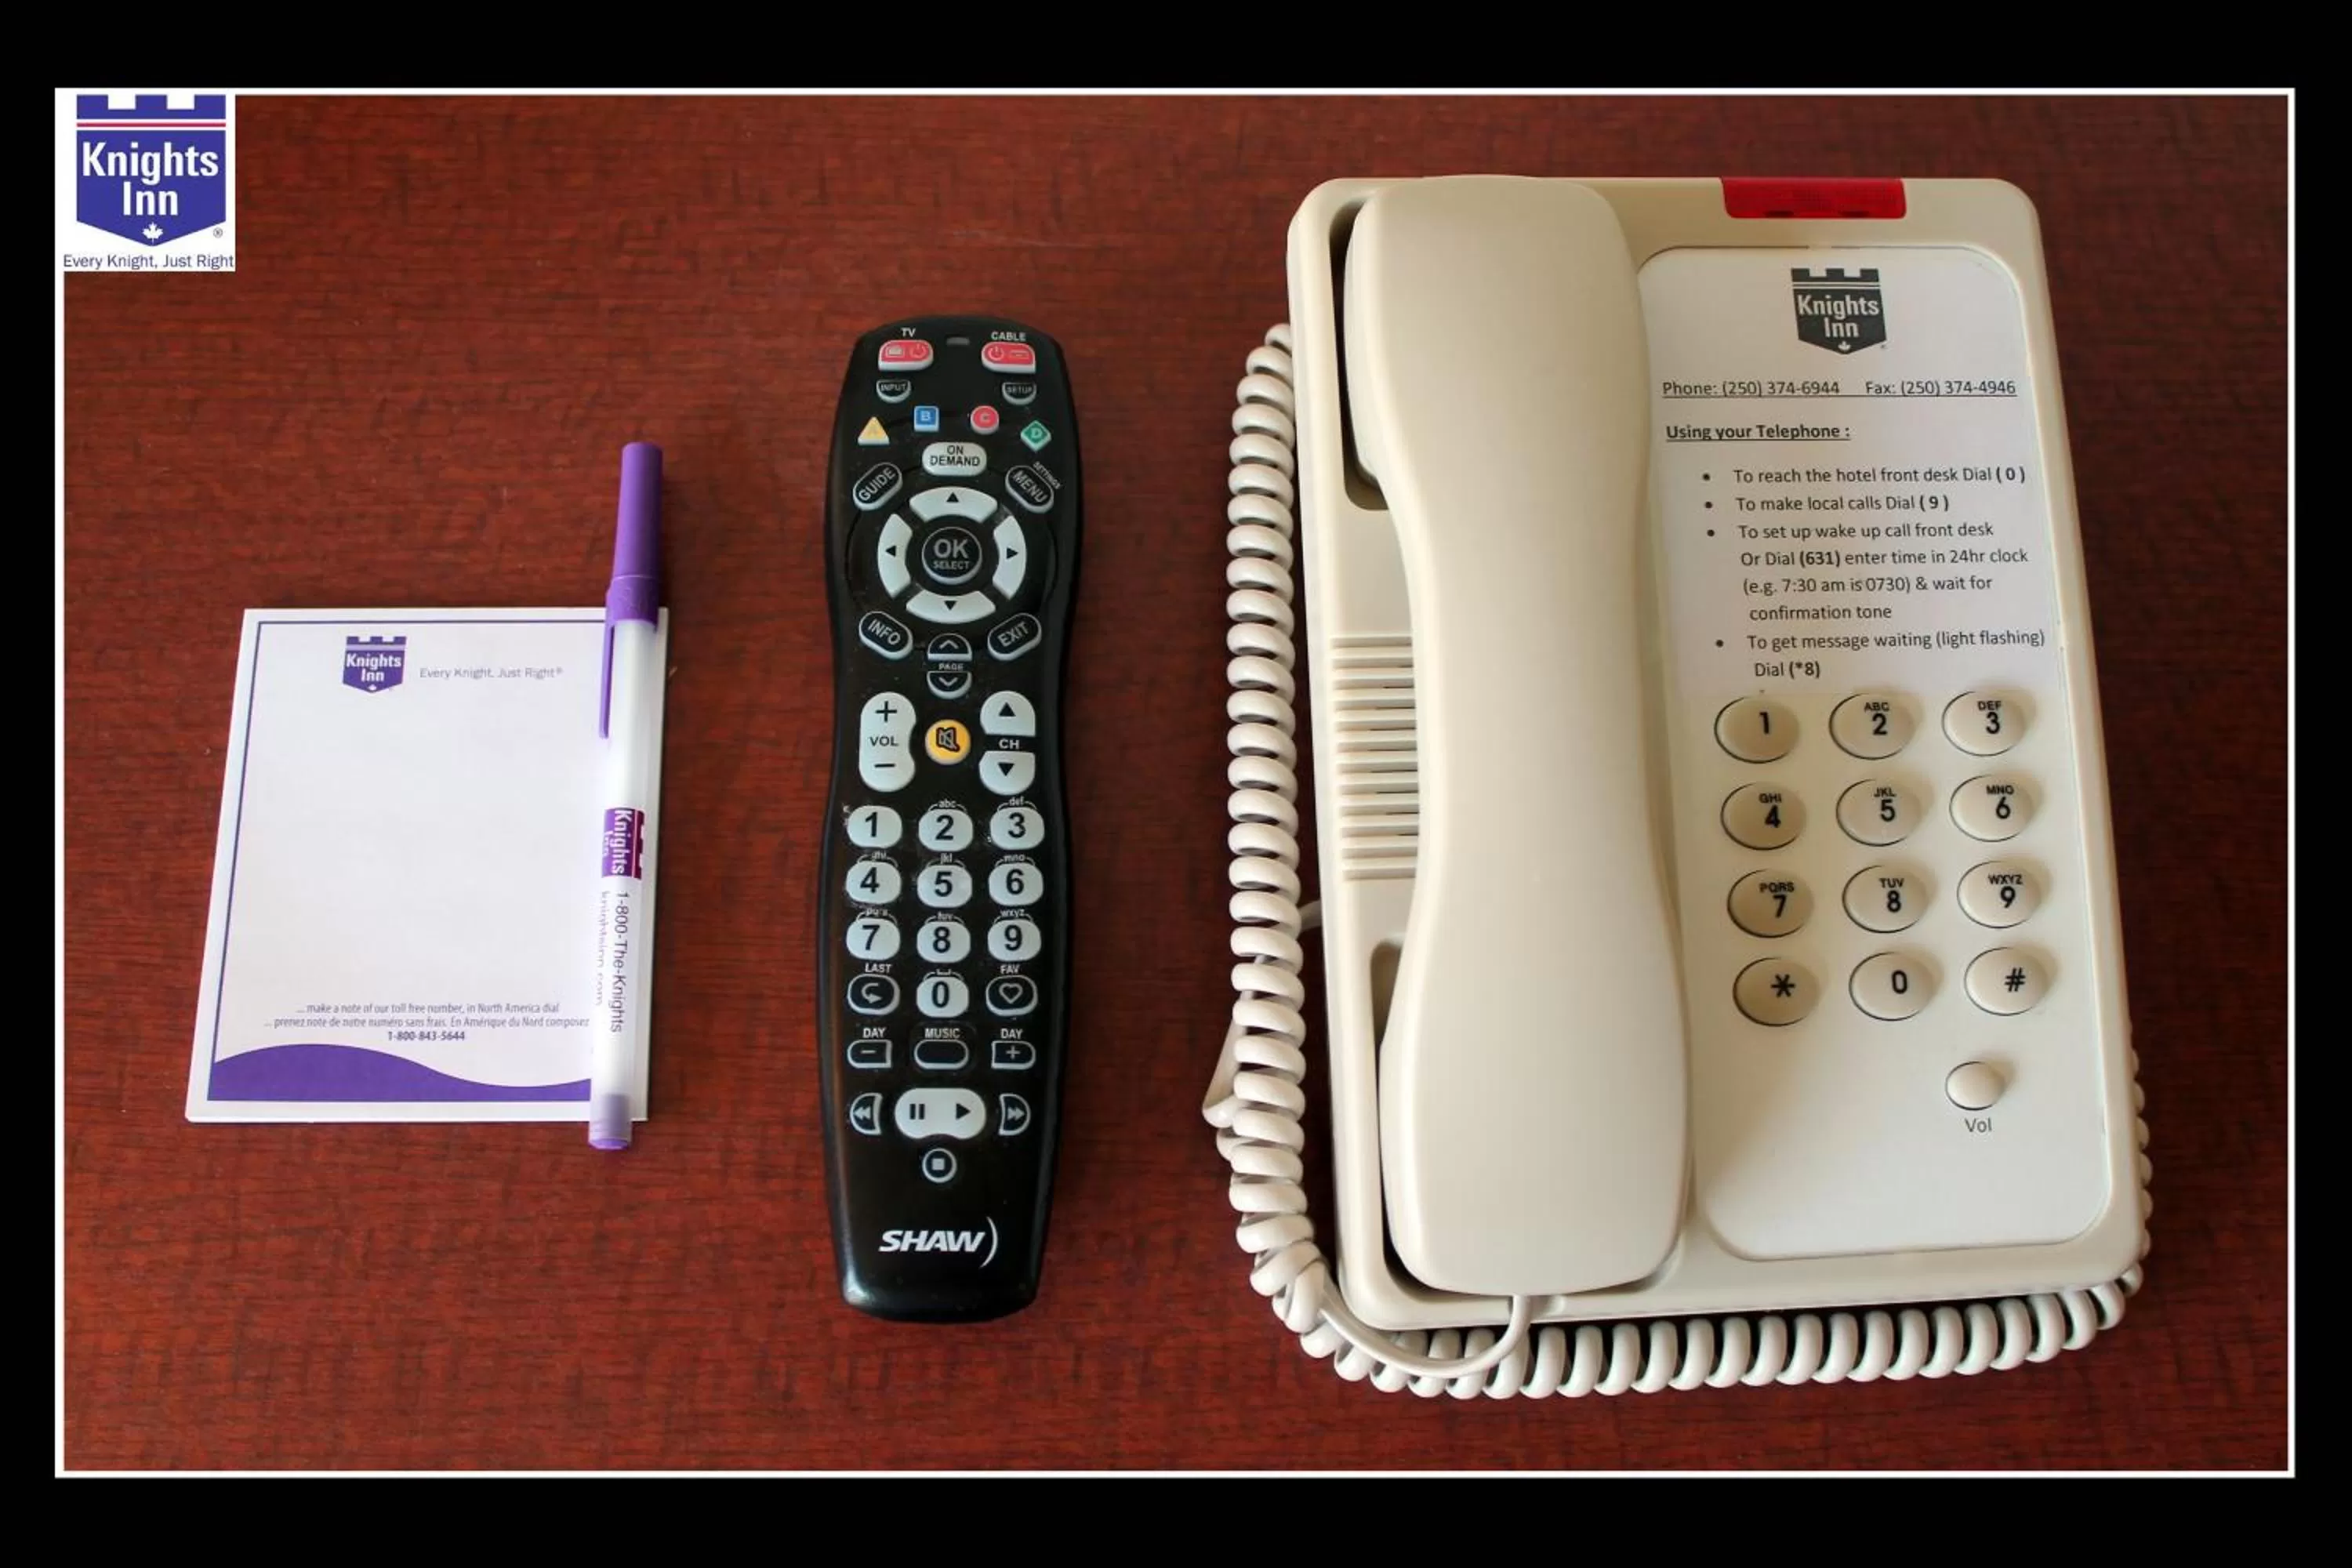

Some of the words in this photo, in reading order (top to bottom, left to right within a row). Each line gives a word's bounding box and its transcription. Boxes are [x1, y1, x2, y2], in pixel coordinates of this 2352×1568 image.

[1797, 295, 1878, 320] Knights
[902, 328, 916, 336] TV
[991, 332, 1025, 341] CABLE
[1824, 318, 1859, 339] Inn
[1663, 381, 1718, 395] Phone:
[1722, 381, 1762, 397] (250)
[1768, 381, 1840, 395] 374-6944
[1866, 381, 1896, 394] Fax:
[1901, 380, 1940, 396] (250)
[1945, 380, 2016, 394] 374-4946
[921, 412, 931, 421] B
[1031, 428, 1040, 438] D
[1667, 425, 1711, 441] Using
[1715, 428, 1752, 440] your
[1756, 425, 1840, 440] Telephone
[930, 456, 980, 466] DEMAND
[858, 468, 895, 501] GUIDE
[1734, 470, 1753, 483] To
[1759, 470, 1801, 483] reach
[1806, 470, 1831, 482] the
[1836, 469, 1876, 481] hotel
[1882, 469, 1918, 481] front
[1924, 468, 1958, 481] desk
[1963, 467, 1991, 481] Dial
[1013, 471, 1047, 502] MENU
[1736, 498, 1755, 510] To
[1761, 497, 1801, 510] make
[1808, 497, 1843, 510] local
[1849, 496, 1881, 510] calls
[1886, 496, 1915, 510] Dial
[1738, 526, 1758, 539] To
[1762, 528, 1787, 539] set
[1792, 529, 1810, 542] up
[1815, 524, 1856, 538] wake
[1861, 528, 1880, 540] up
[1886, 524, 1910, 537] call
[1915, 524, 1952, 537] front
[1958, 523, 1993, 536] desk
[934, 539, 968, 558] OK
[1741, 553, 1761, 566] Or
[1766, 552, 1795, 565] Dial
[1799, 550, 1840, 568] (631)
[1846, 552, 1886, 564] enter
[1892, 551, 1926, 564] time
[1931, 551, 1945, 564] in
[1950, 550, 1984, 564] 24hr
[1989, 549, 2027, 563] clock
[1744, 579, 1777, 595] (e.g.
[1783, 579, 1817, 593] 7:30
[1822, 581, 1845, 591] am
[1850, 579, 1864, 591] is
[1865, 578, 1911, 594] 0730)
[1916, 578, 1927, 590] &
[1933, 577, 1965, 590] wait
[1969, 576, 1993, 590] for
[1750, 606, 1851, 621] confirmation
[1857, 607, 1891, 619] tone
[868, 619, 900, 644] INFO
[998, 622, 1028, 648] EXIT
[1748, 636, 1767, 649] To
[1772, 636, 1797, 653] get
[1802, 637, 1869, 652] message
[1875, 633, 1932, 650] waiting
[1936, 631, 1975, 648] (light
[1980, 630, 2045, 647] flashing)
[347, 654, 401, 670] Knights
[1755, 663, 1784, 677] Dial
[361, 669, 384, 682] Inn
[420, 668, 449, 679] Every
[497, 668, 520, 678] Just
[1864, 702, 1889, 712] ABC
[1978, 700, 2001, 711] DEF
[1759, 713, 1769, 735] 1
[1872, 713, 1887, 735] 2
[1986, 713, 2000, 735] 3
[870, 737, 898, 746] VOL
[999, 739, 1019, 749] CH
[1759, 793, 1781, 804] GHI
[1874, 787, 1896, 797] JKL
[1987, 785, 2014, 795] MNO
[1765, 805, 1780, 829] 4
[1881, 800, 1896, 822] 5
[1996, 797, 2010, 819] 6
[866, 812, 877, 837] 1
[936, 815, 953, 840] 2
[1008, 813, 1025, 837] 3
[612, 810, 633, 874] Knights
[860, 867, 880, 893] 4
[935, 872, 953, 896] 5
[1007, 869, 1024, 894] 6
[1759, 882, 1794, 893] PQRS
[1879, 878, 1904, 889] TUV
[1988, 874, 2024, 885] WXYZ
[1773, 895, 1786, 918] 7
[1887, 890, 1902, 913] 8
[2000, 887, 2016, 909] 9
[862, 925, 880, 950] 7
[933, 927, 950, 953] 8
[1004, 925, 1022, 950] 9
[609, 891, 630, 1033] 1-800-The-Knights
[866, 964, 891, 973] LAST
[1892, 971, 1907, 994] 0
[932, 982, 949, 1007] 0
[478, 1004, 503, 1014] North
[505, 1004, 540, 1014] America
[543, 1004, 559, 1014] dial
[388, 1031, 465, 1041] 1-800-843-5644
[863, 1029, 886, 1038] DAY
[925, 1029, 960, 1038] MUSIC
[1001, 1029, 1022, 1038] DAY
[1964, 1117, 1992, 1132] Vol
[879, 1230, 985, 1251] SHAW
